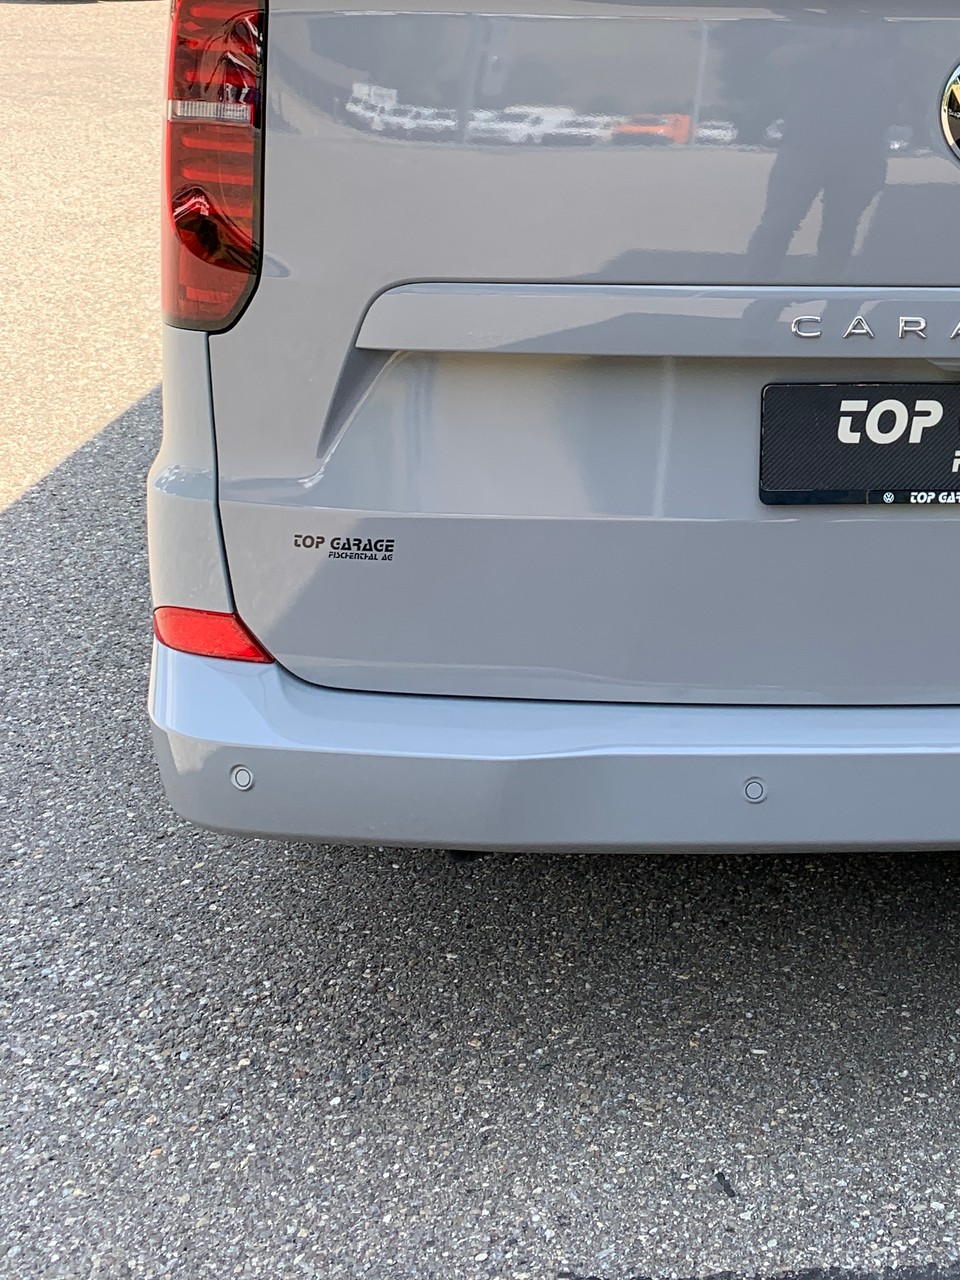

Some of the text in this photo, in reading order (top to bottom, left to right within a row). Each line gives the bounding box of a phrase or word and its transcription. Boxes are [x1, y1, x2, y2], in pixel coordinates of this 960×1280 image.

[837, 400, 943, 444] TOP
[910, 492, 936, 503] TOP
[293, 534, 395, 552] TOP GARAGE
[328, 551, 393, 561] FISCHENTHAL AG
